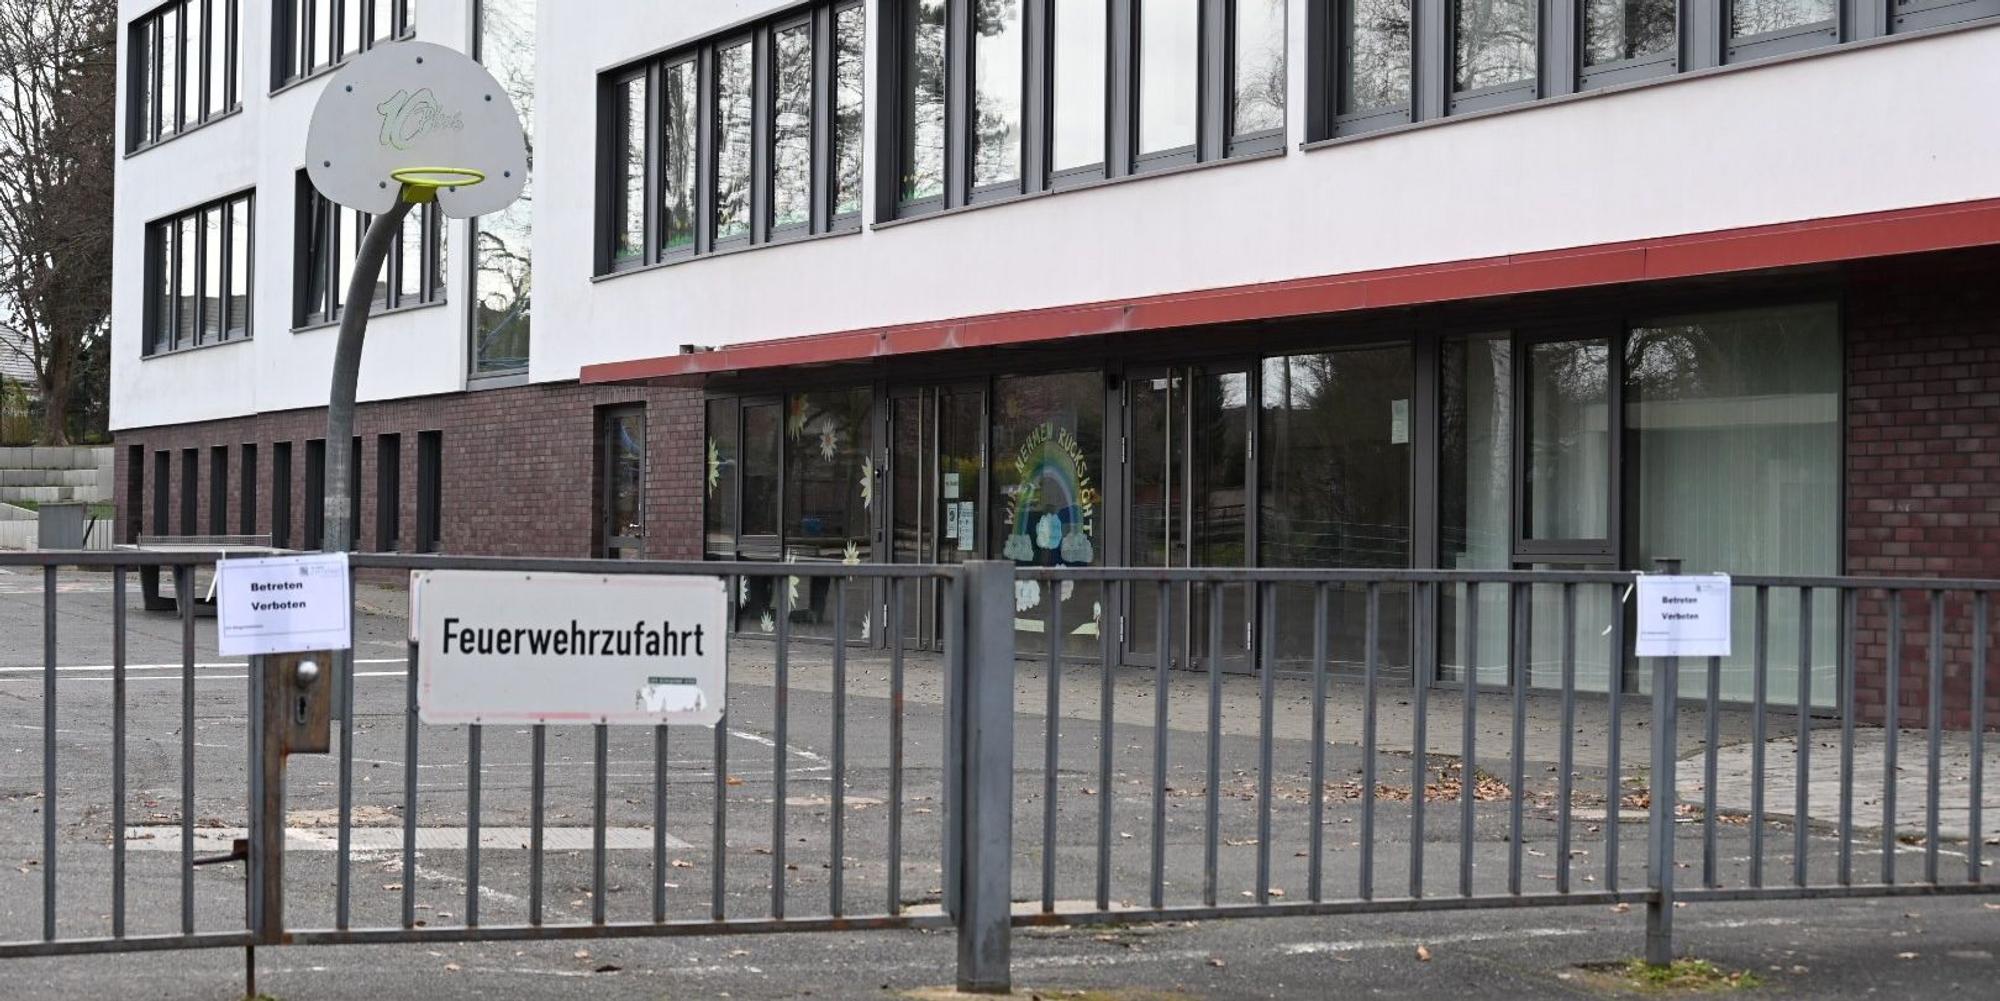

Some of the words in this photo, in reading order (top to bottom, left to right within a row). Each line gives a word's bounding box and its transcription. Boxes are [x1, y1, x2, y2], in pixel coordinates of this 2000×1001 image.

[1015, 423, 1054, 474] NEHMEN
[251, 582, 303, 592] Betreten
[1661, 596, 1698, 604] Betreten
[251, 600, 307, 611] Verboten
[1661, 612, 1699, 620] Verboten
[442, 617, 704, 657] Feuerwehrzufahrt
